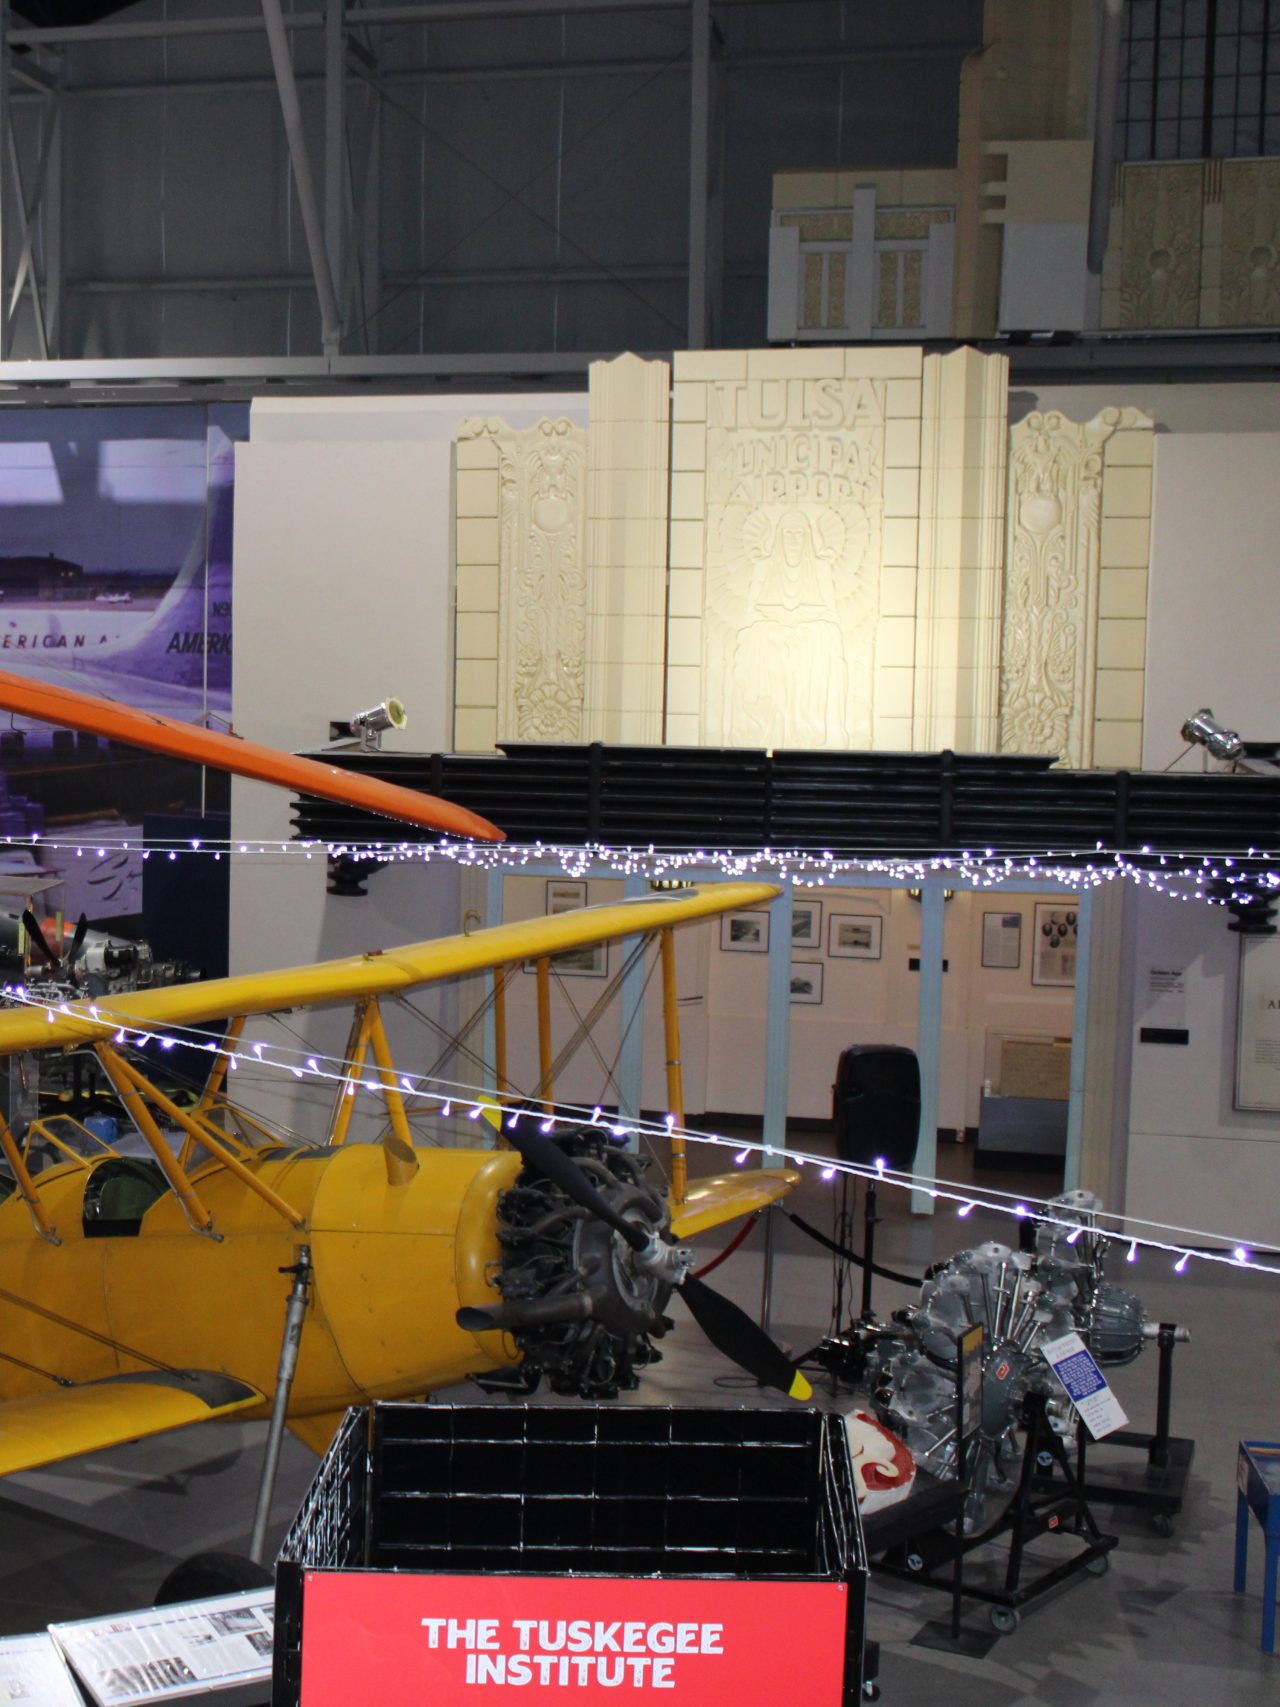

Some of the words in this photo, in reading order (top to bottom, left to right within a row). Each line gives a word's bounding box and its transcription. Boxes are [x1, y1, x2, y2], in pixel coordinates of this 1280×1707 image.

[713, 379, 885, 431] TULSA
[718, 432, 880, 476] MUNICIPAL
[725, 472, 873, 502] AIRPORT
[421, 1618, 501, 1649] THE
[513, 1619, 725, 1655] TUSKEGEE
[466, 1653, 676, 1688] INSTITUTE
